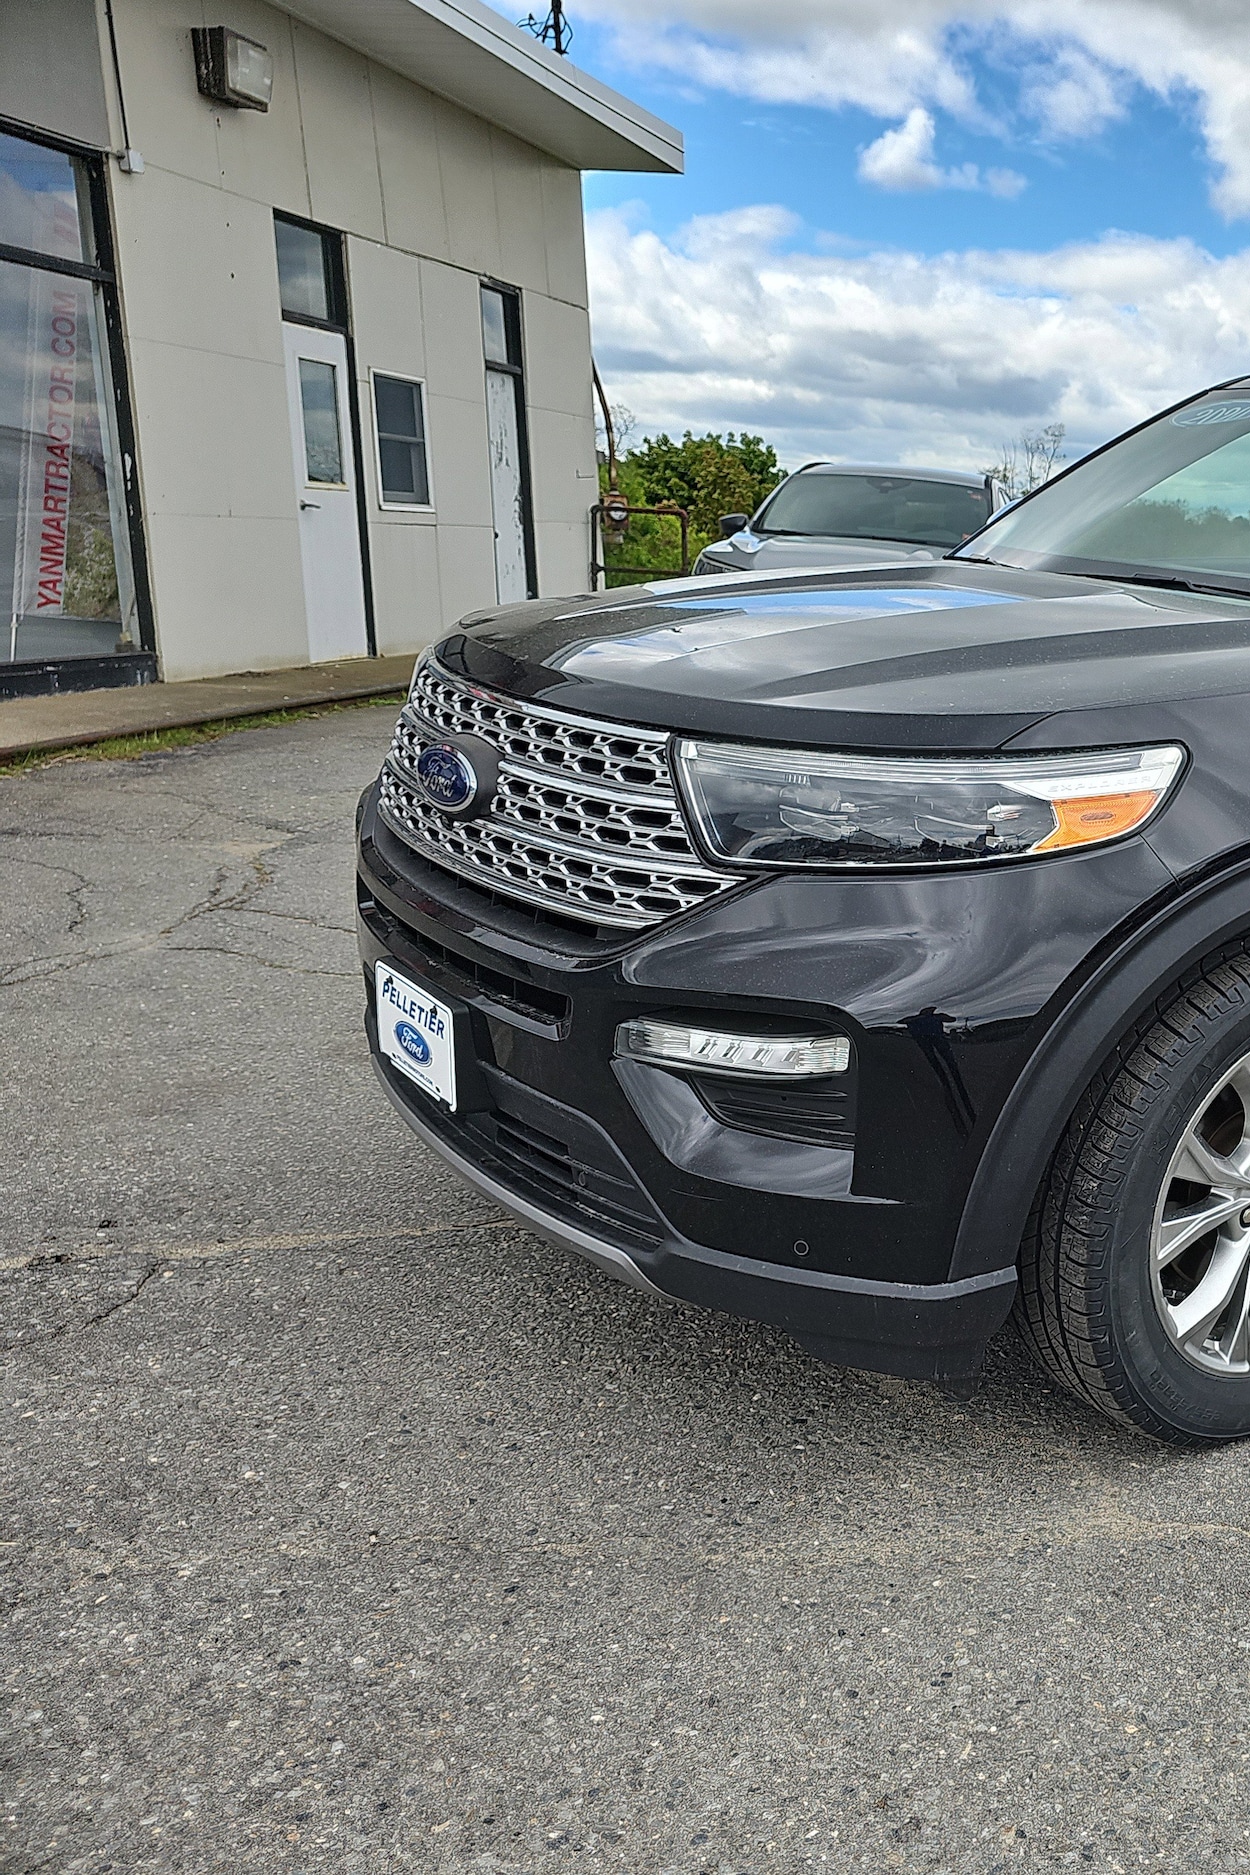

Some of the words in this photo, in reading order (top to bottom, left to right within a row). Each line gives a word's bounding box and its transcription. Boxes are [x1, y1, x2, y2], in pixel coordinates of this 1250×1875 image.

[37, 290, 77, 609] YANMARTRACTOR.COM
[423, 756, 457, 798] Ford
[1048, 776, 1151, 793] EXPLORER
[382, 980, 445, 1040] PELLETIER
[401, 1026, 424, 1060] Ford
